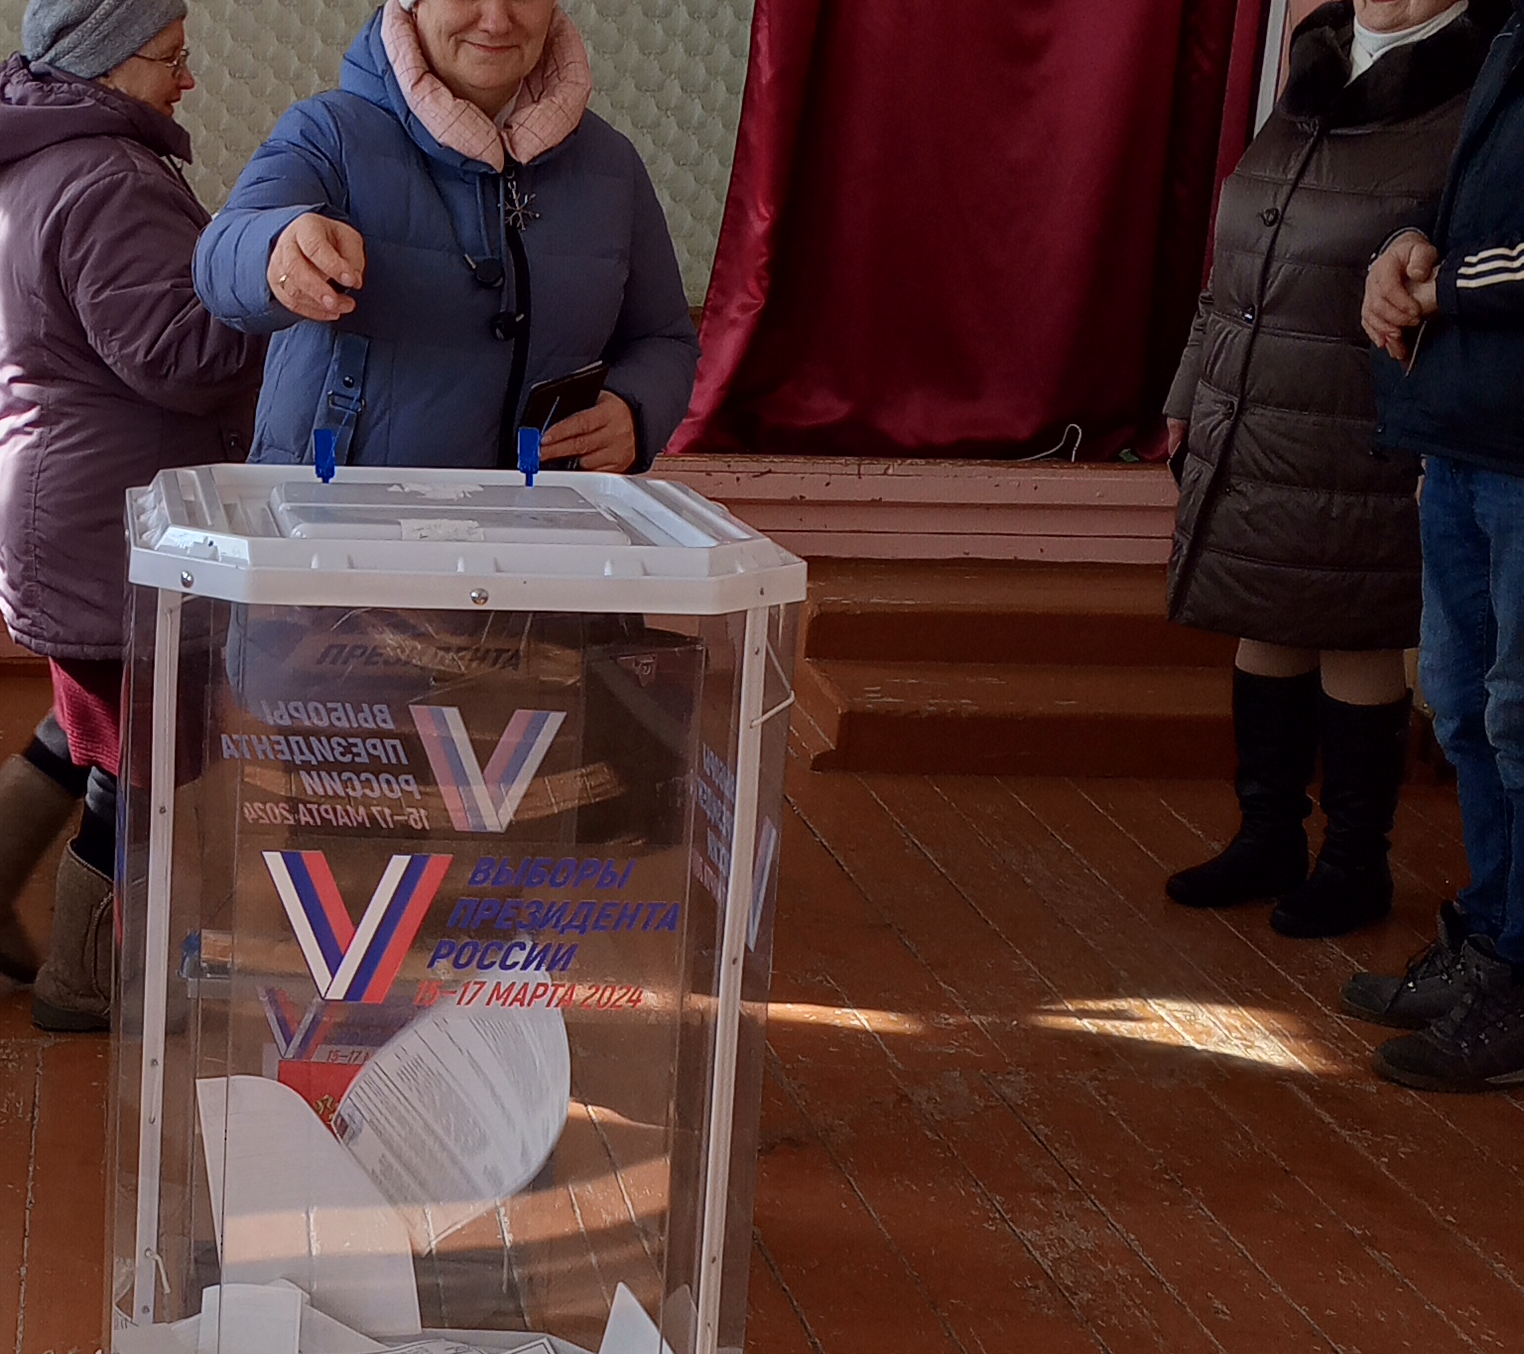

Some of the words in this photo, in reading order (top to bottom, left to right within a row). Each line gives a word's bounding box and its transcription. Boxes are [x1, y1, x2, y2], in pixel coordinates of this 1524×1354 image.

[316, 644, 522, 671] ПРЕНТА
[468, 856, 636, 891] ВЫБОРЫ
[447, 897, 682, 935] ПРЕЗИДЕНТА
[427, 939, 579, 973] РОССИИ
[485, 981, 576, 1009] МАРТА
[579, 985, 643, 1010] 2024
